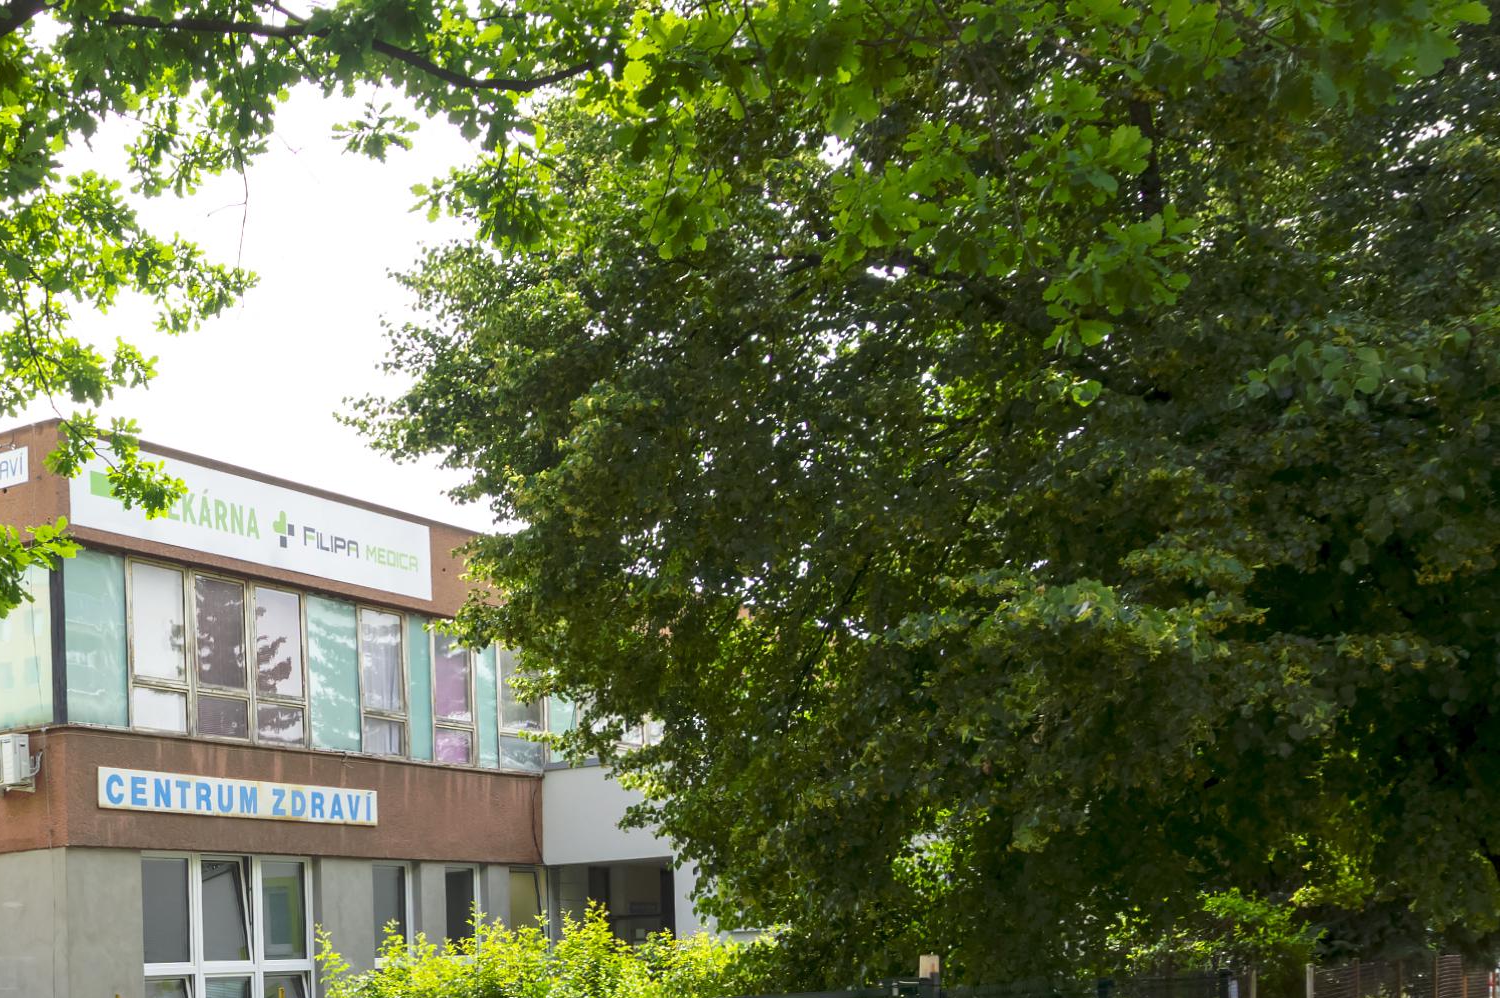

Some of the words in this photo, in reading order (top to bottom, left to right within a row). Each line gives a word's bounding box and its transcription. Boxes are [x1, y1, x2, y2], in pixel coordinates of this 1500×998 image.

[167, 489, 260, 540] KÁRNA
[303, 526, 359, 559] FILIPA
[366, 545, 419, 573] MEDICA
[105, 774, 258, 815] CENTRUM
[271, 789, 372, 822] ZDRAVÍ
